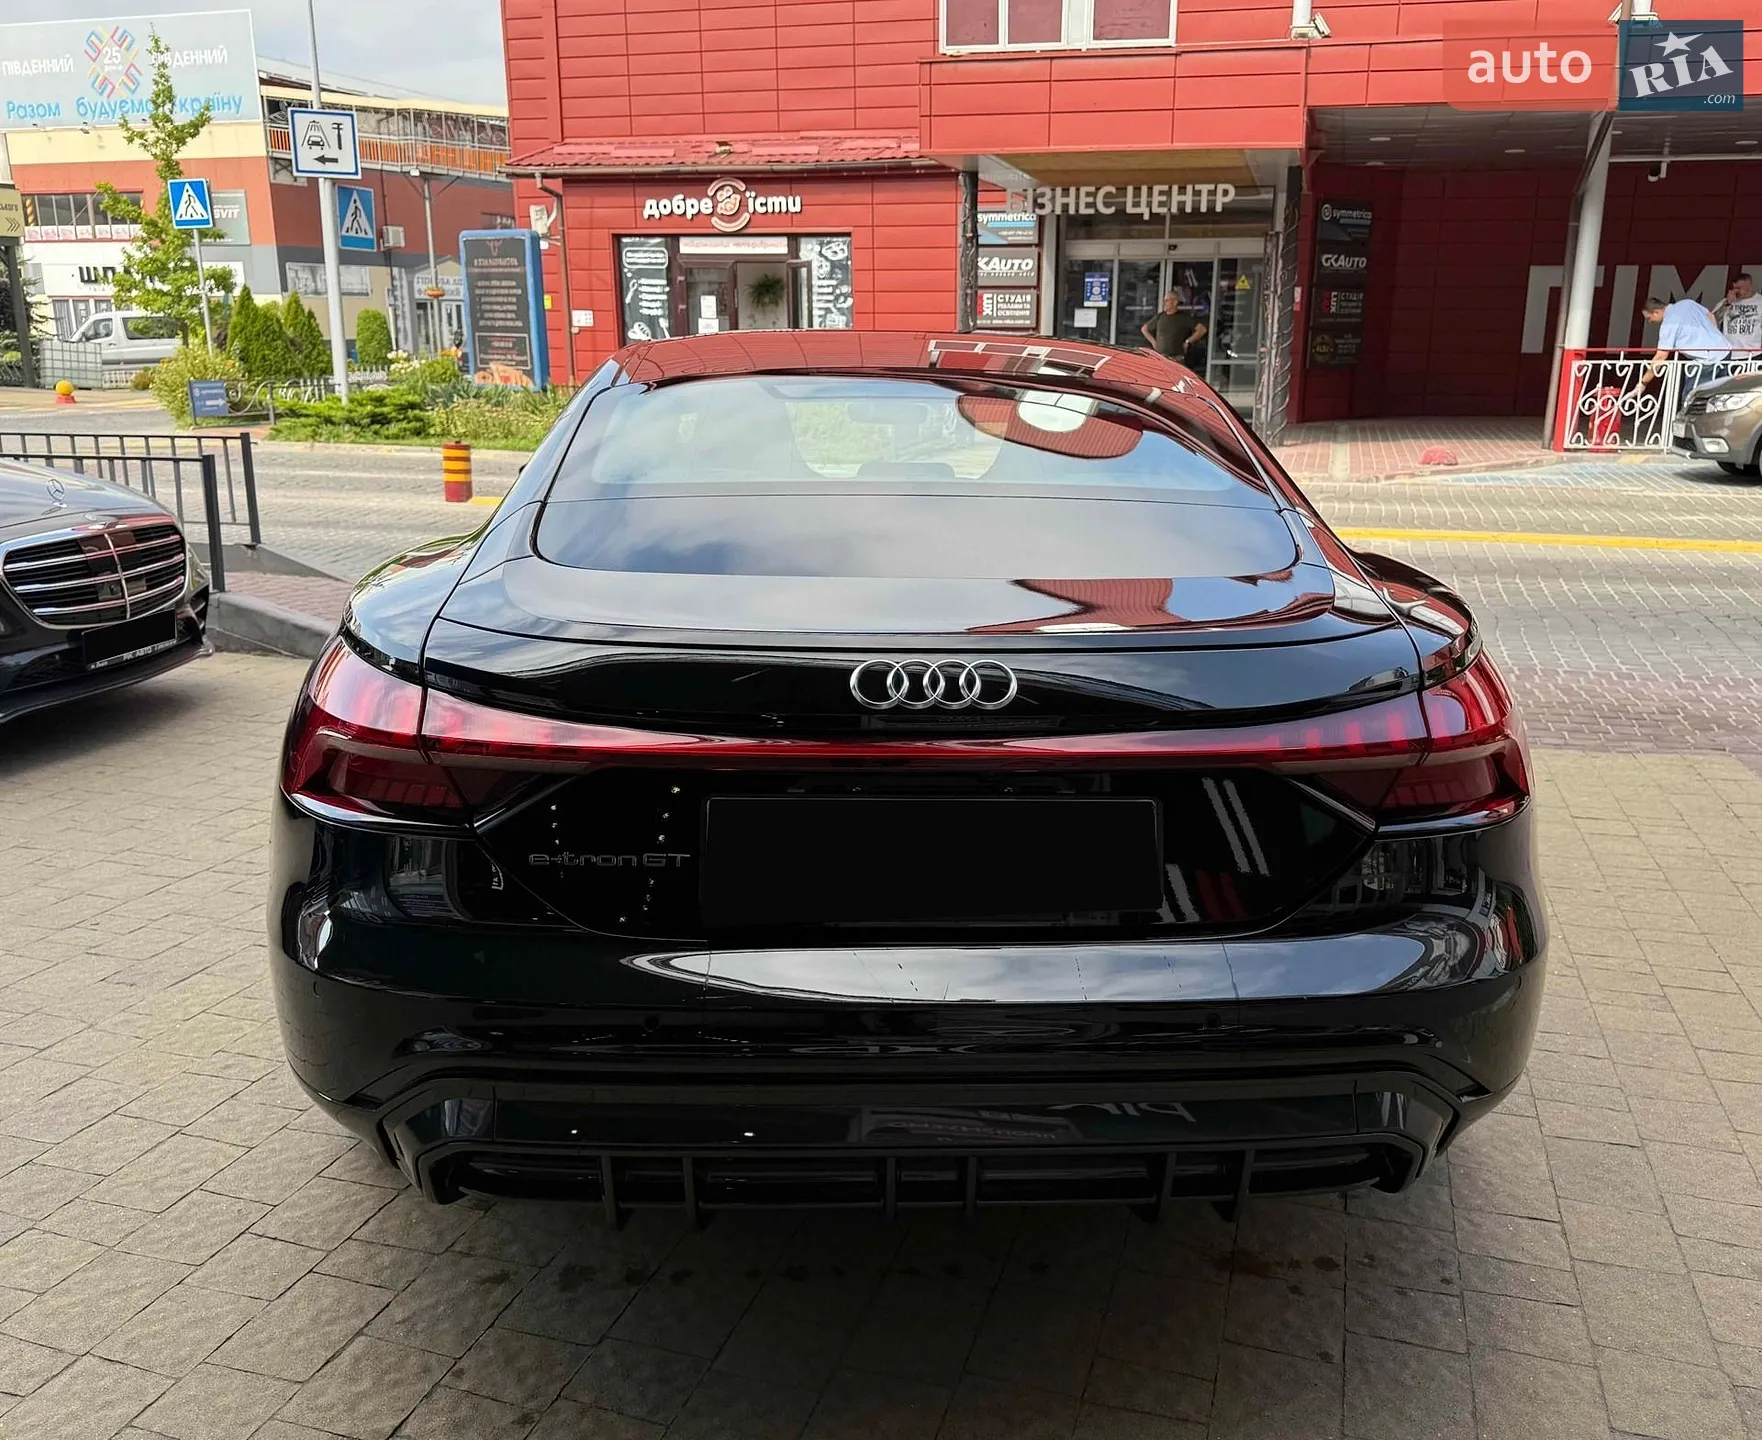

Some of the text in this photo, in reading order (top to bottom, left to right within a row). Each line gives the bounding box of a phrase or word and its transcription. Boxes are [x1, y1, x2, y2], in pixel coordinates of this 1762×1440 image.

[103, 46, 122, 65] 25
[6, 101, 61, 120] Разом
[172, 92, 243, 116] країну
[643, 190, 802, 220] добре їсти
[1005, 183, 1237, 220] БІЗНЕС ЦЕНТР
[528, 851, 691, 867] e-tron GT
